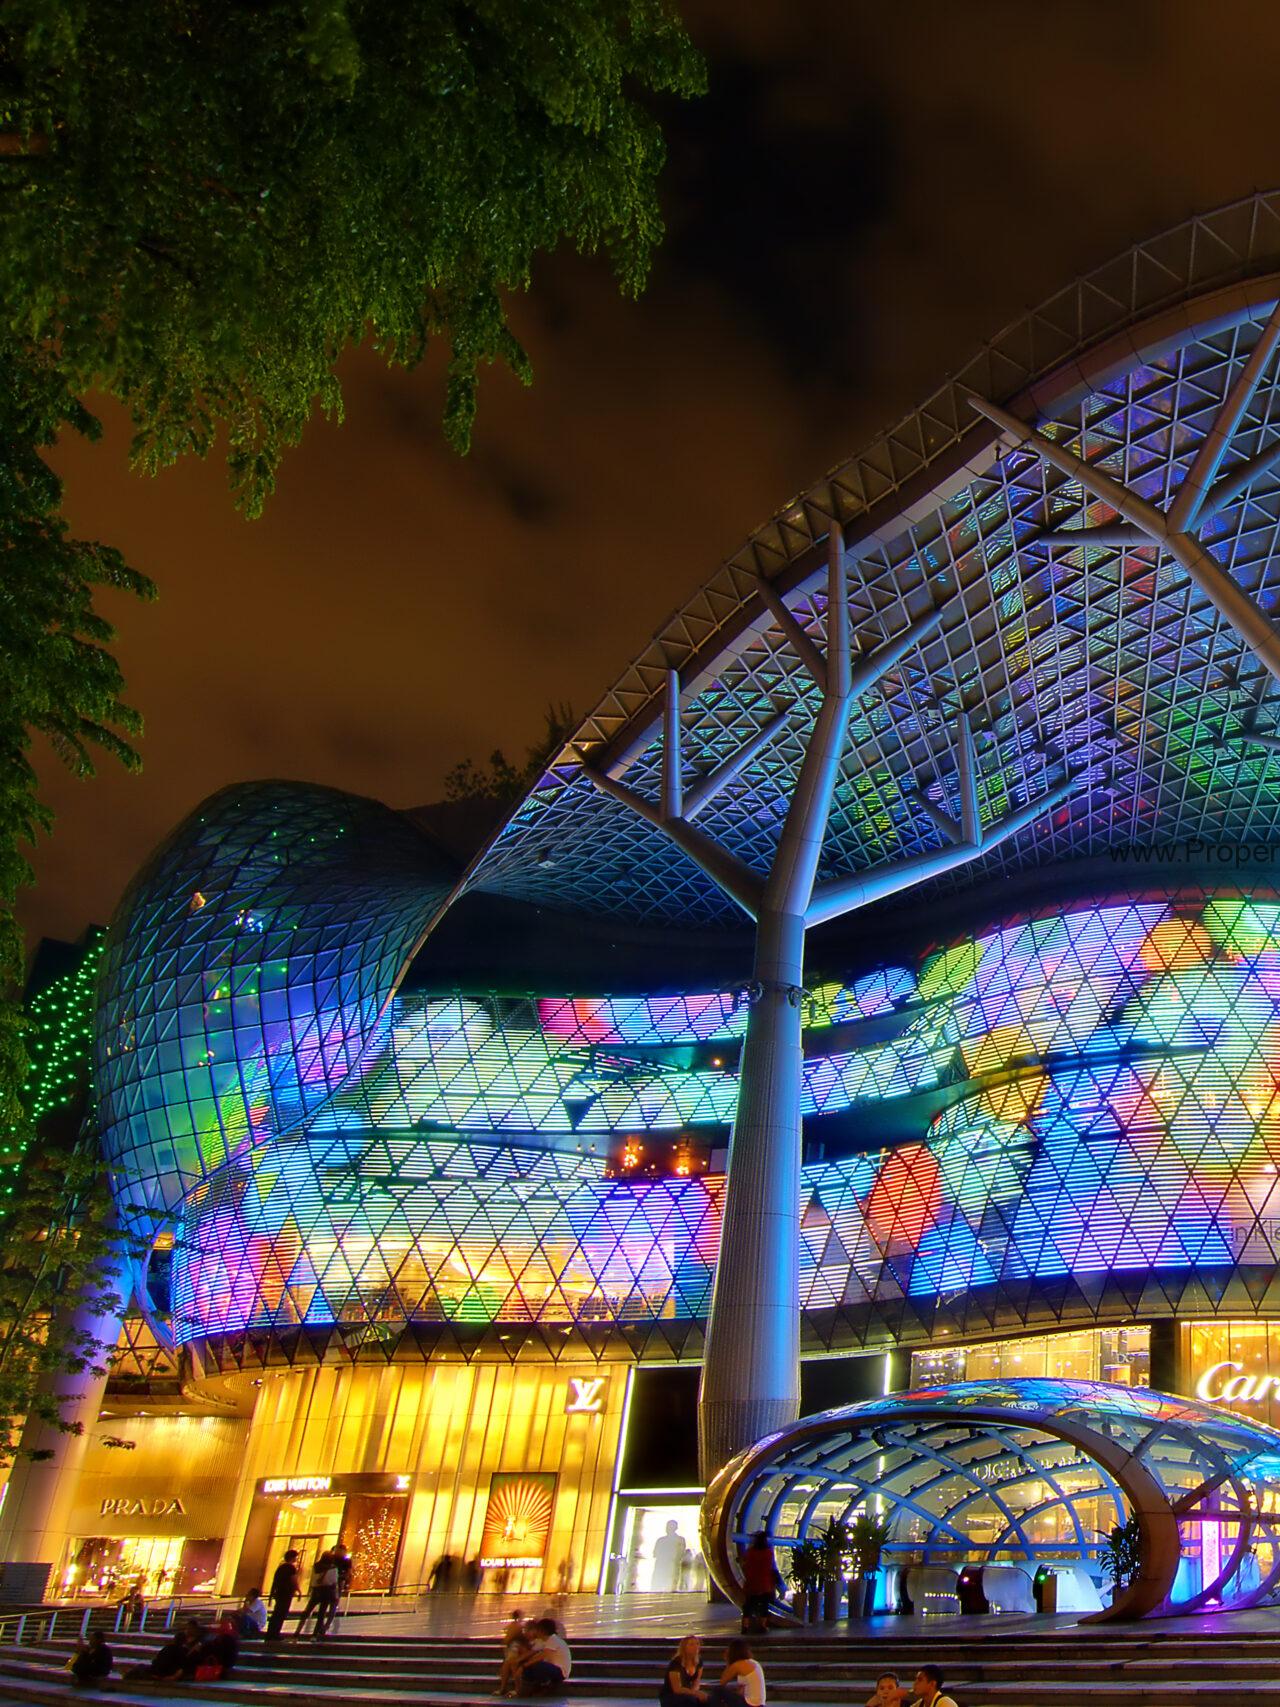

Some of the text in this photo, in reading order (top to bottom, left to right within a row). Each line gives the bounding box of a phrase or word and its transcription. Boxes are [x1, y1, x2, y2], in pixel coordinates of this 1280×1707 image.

[567, 1378, 604, 1412] LV
[288, 1477, 331, 1490] VUITTON
[101, 1498, 187, 1515] PRADA
[480, 1557, 543, 1567] LOUIS VUITTON
